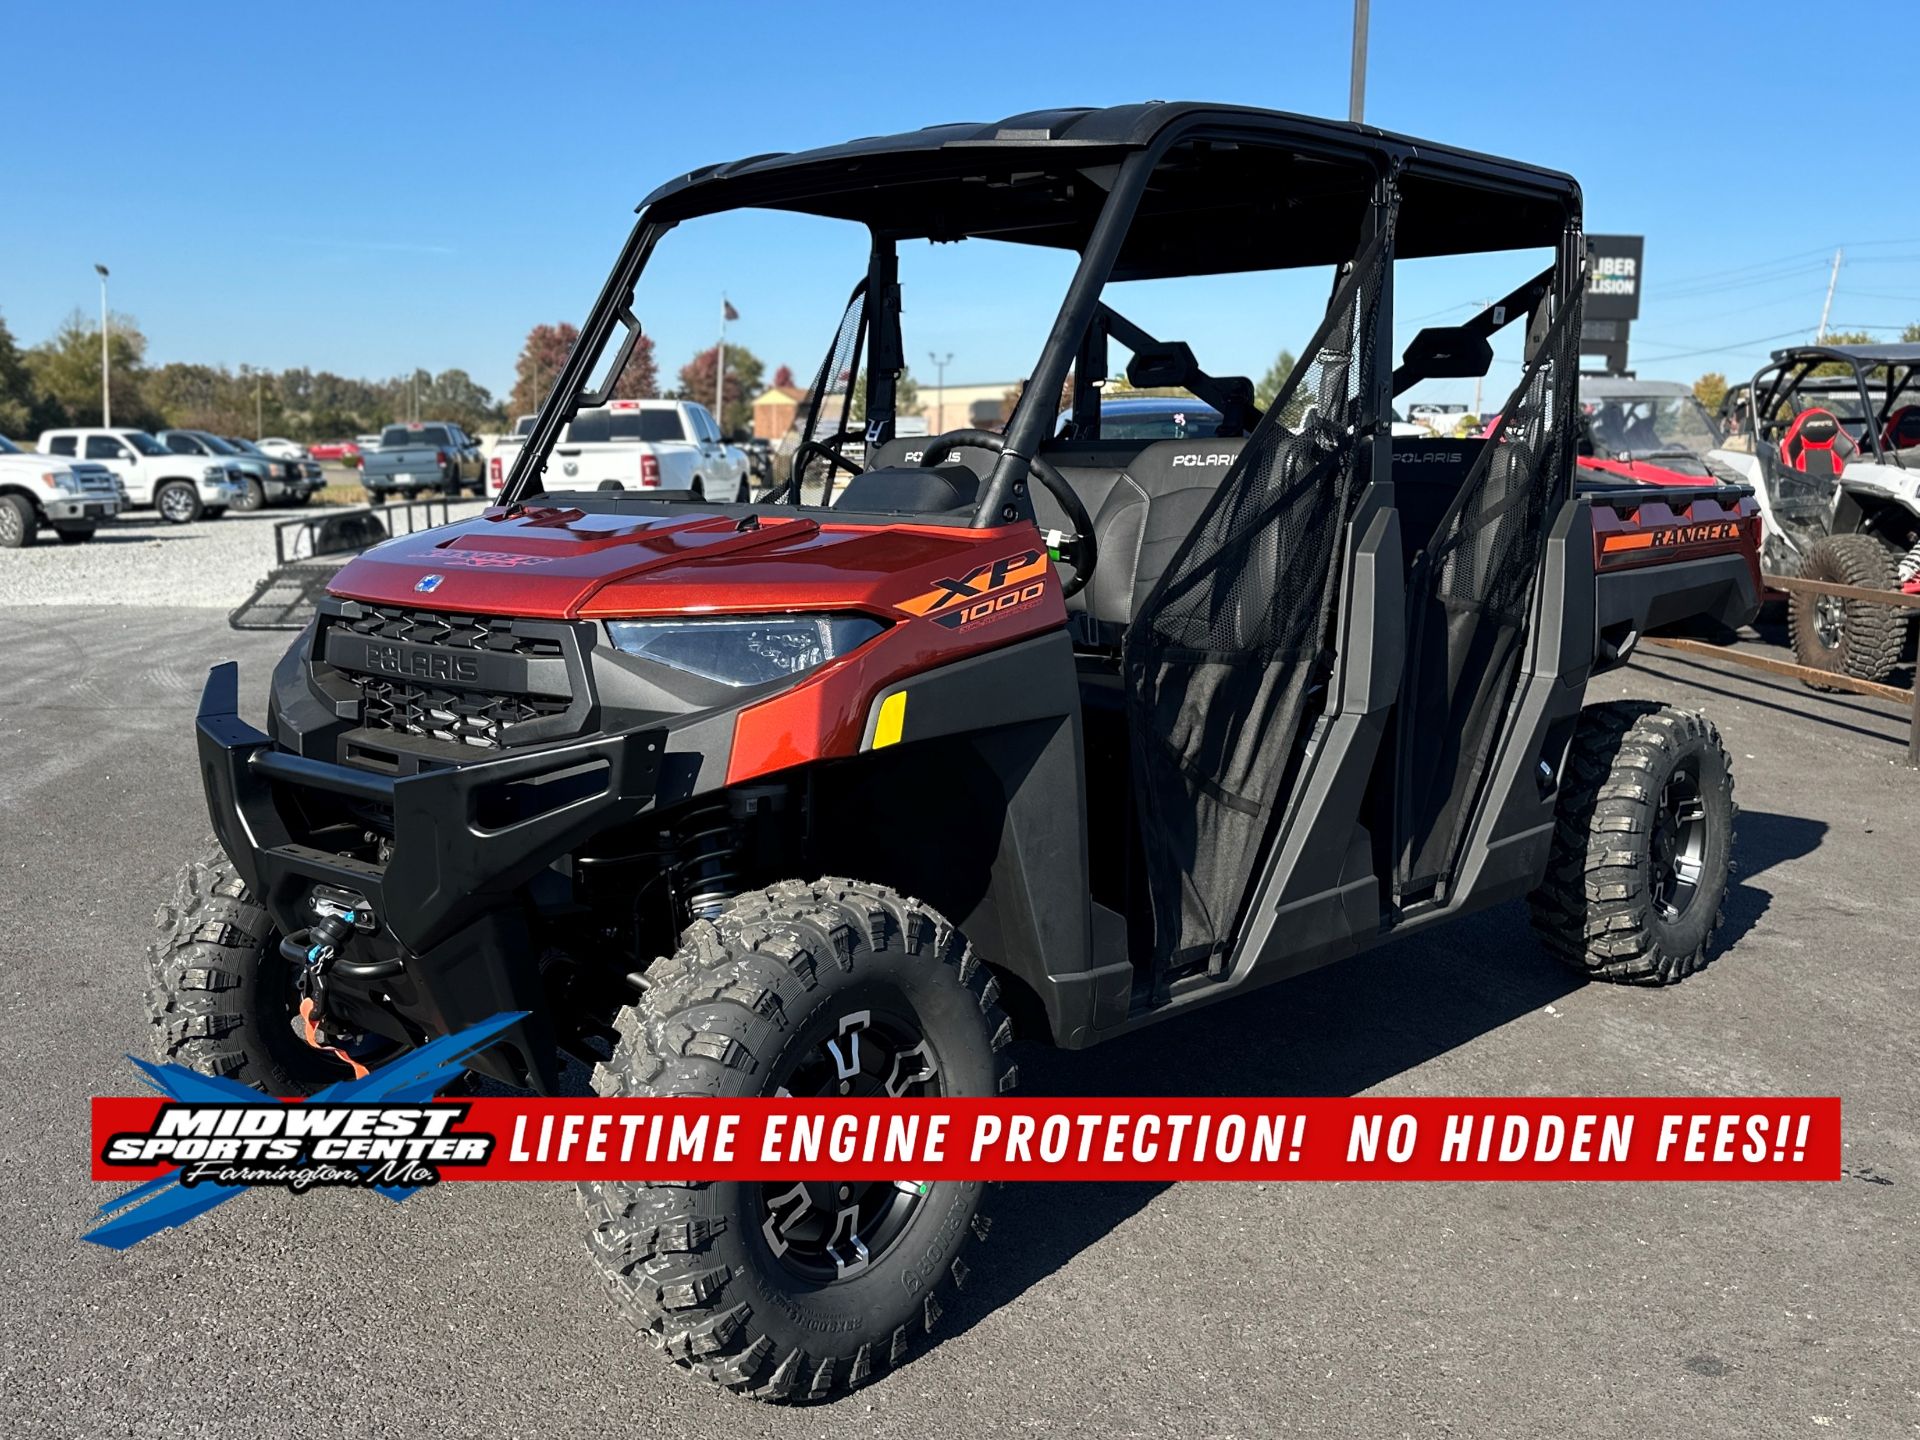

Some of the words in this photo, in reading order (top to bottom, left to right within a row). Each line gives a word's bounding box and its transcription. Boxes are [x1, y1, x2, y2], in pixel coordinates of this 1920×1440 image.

[904, 452, 962, 463] POIS
[1172, 453, 1239, 467] POLARI
[1650, 523, 1732, 548] RANGER
[925, 549, 1042, 613] XP
[959, 582, 1045, 625] 1000
[365, 643, 480, 683] POLARIS
